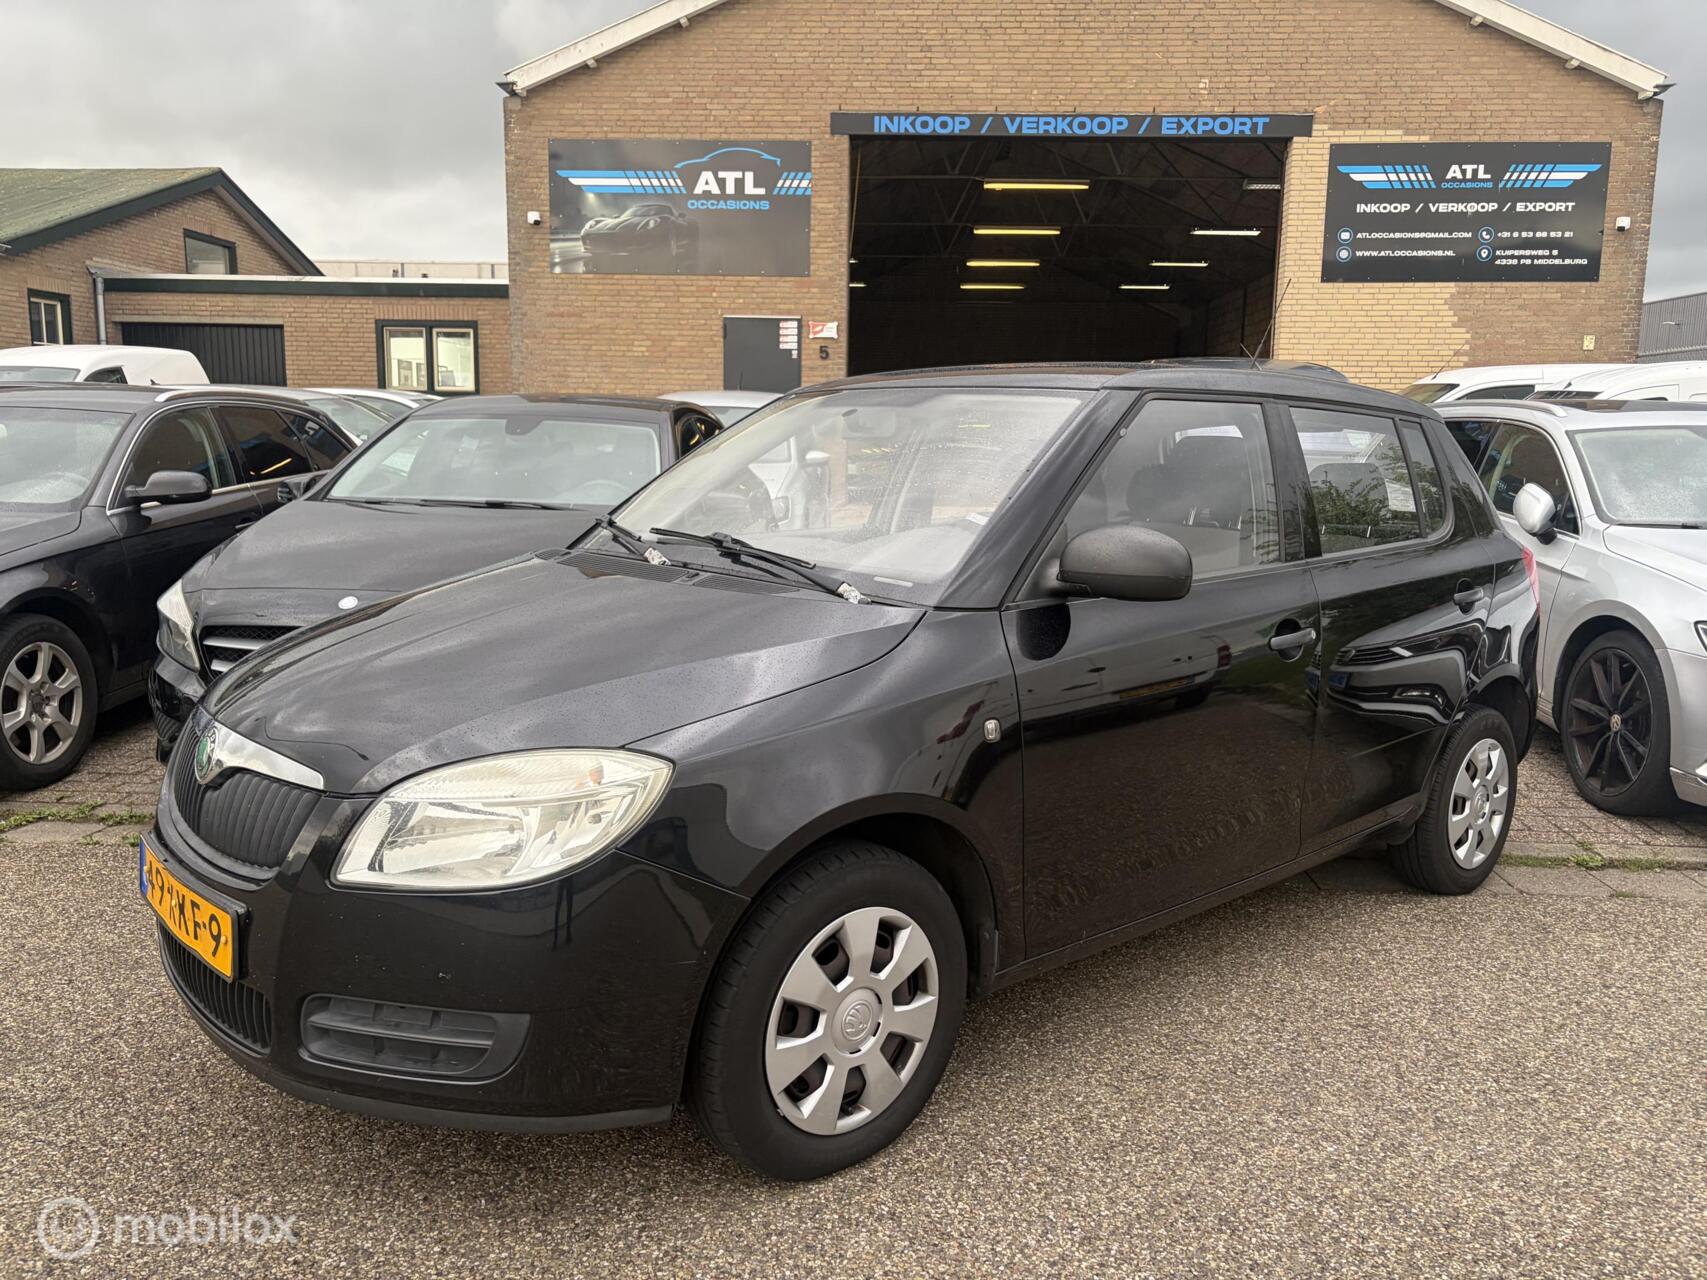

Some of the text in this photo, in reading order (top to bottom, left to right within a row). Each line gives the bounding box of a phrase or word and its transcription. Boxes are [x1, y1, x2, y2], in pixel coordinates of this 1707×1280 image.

[873, 115, 1270, 135] INKOOP / VERKOOP / EXPORT
[1445, 164, 1492, 179] ATL
[693, 171, 766, 195] ATL
[1440, 181, 1494, 189] OCCASIONS
[687, 200, 770, 210] OCCASIONS
[1356, 203, 1411, 214] INKOOP
[1428, 202, 1498, 213] VERKOOP
[1515, 202, 1576, 213] EXPORT
[819, 345, 830, 360] 5
